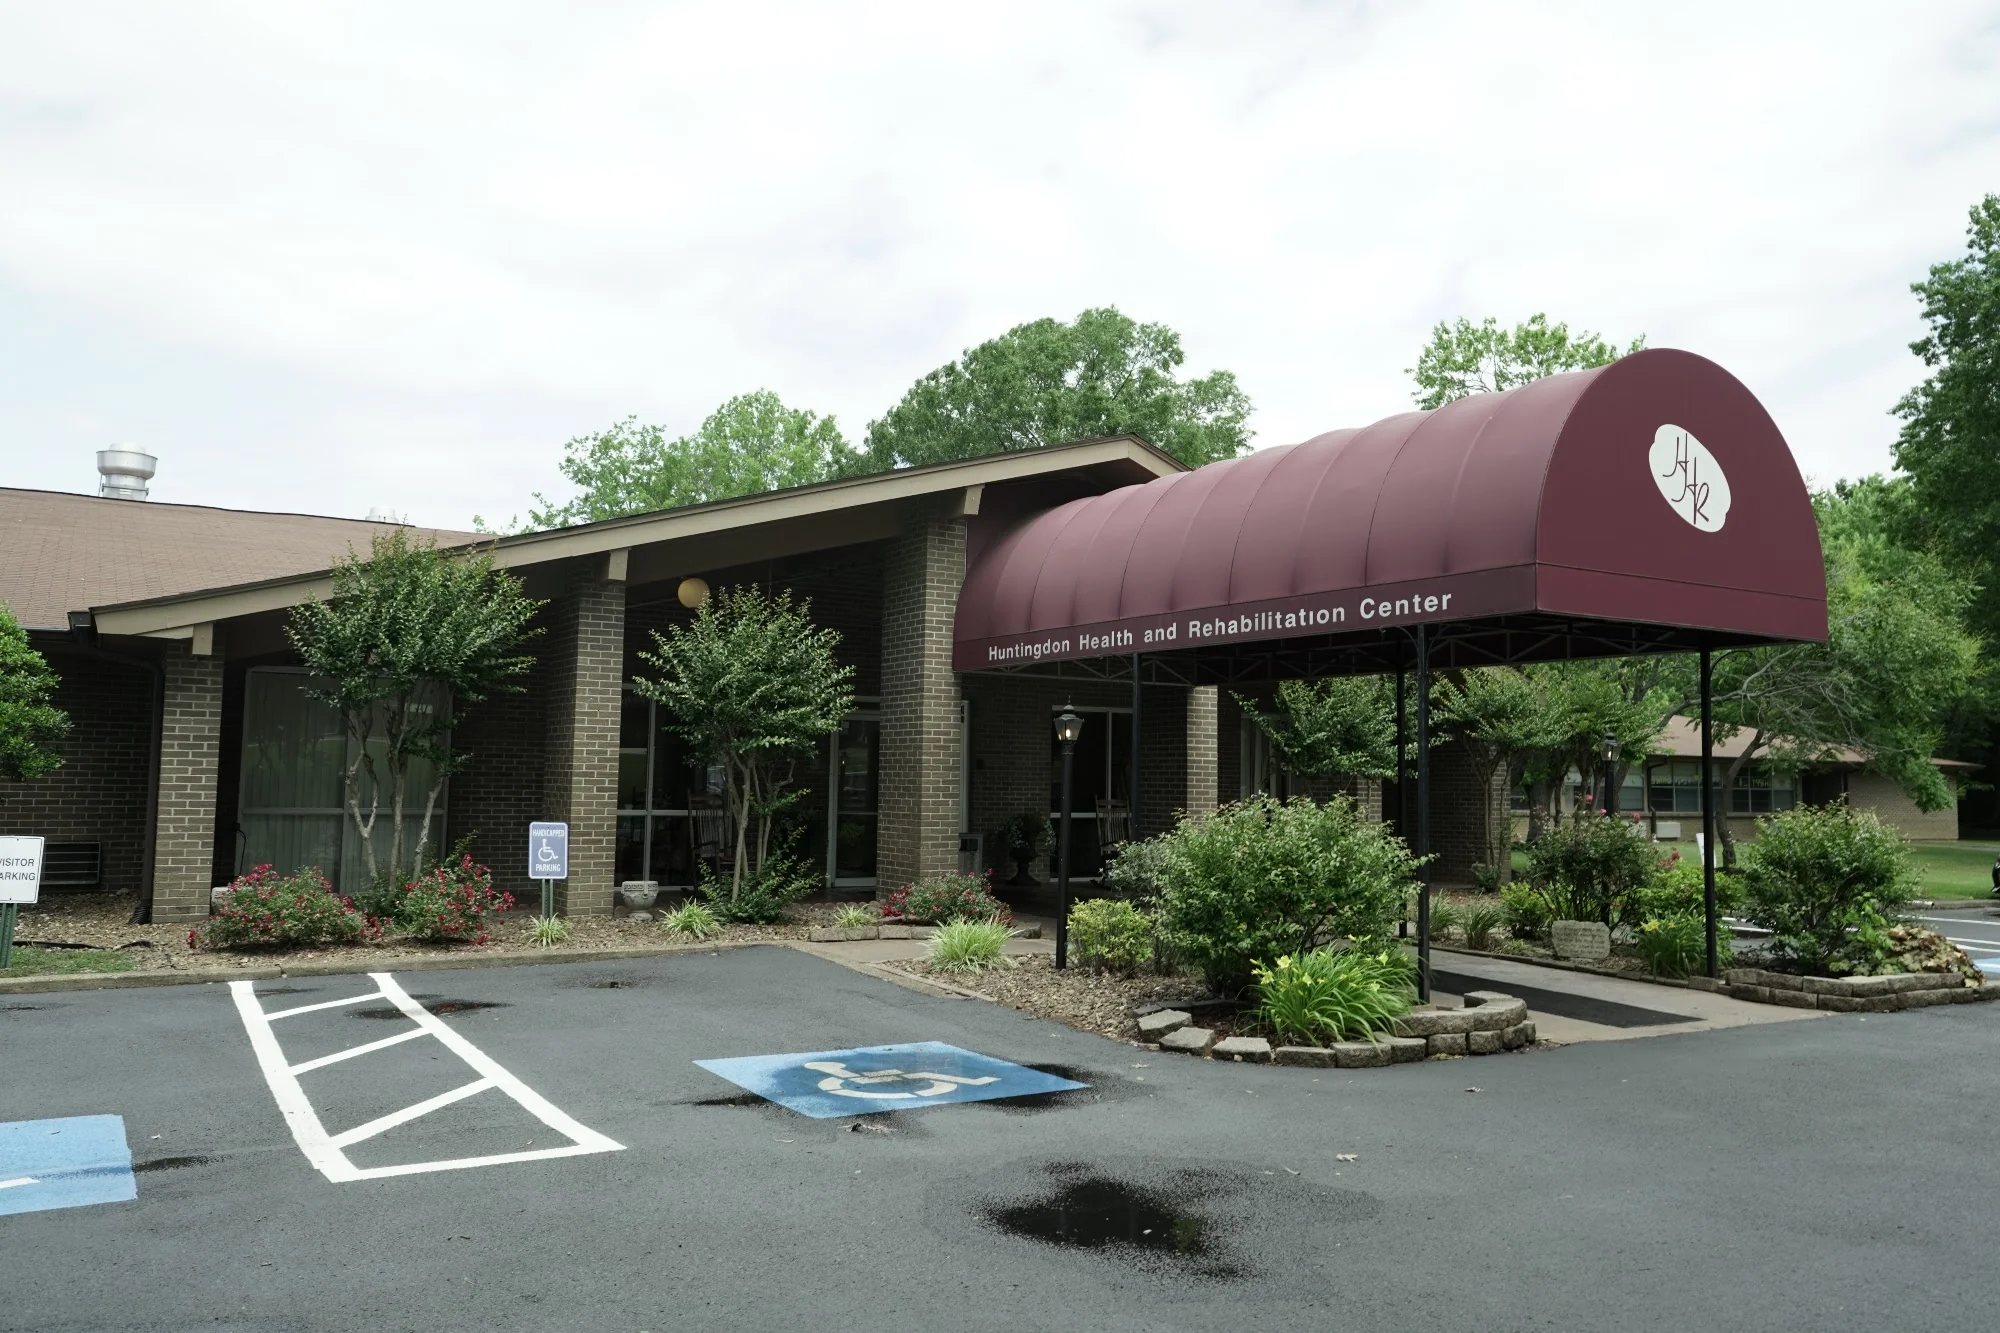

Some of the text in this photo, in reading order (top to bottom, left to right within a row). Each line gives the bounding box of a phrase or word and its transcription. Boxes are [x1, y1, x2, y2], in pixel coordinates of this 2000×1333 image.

[988, 593, 1452, 661] Huntingdon Health and Rehabilitation Center
[532, 828, 565, 837] HANDICAPPED
[0, 857, 35, 867] ISITOR
[535, 863, 561, 872] PARKING
